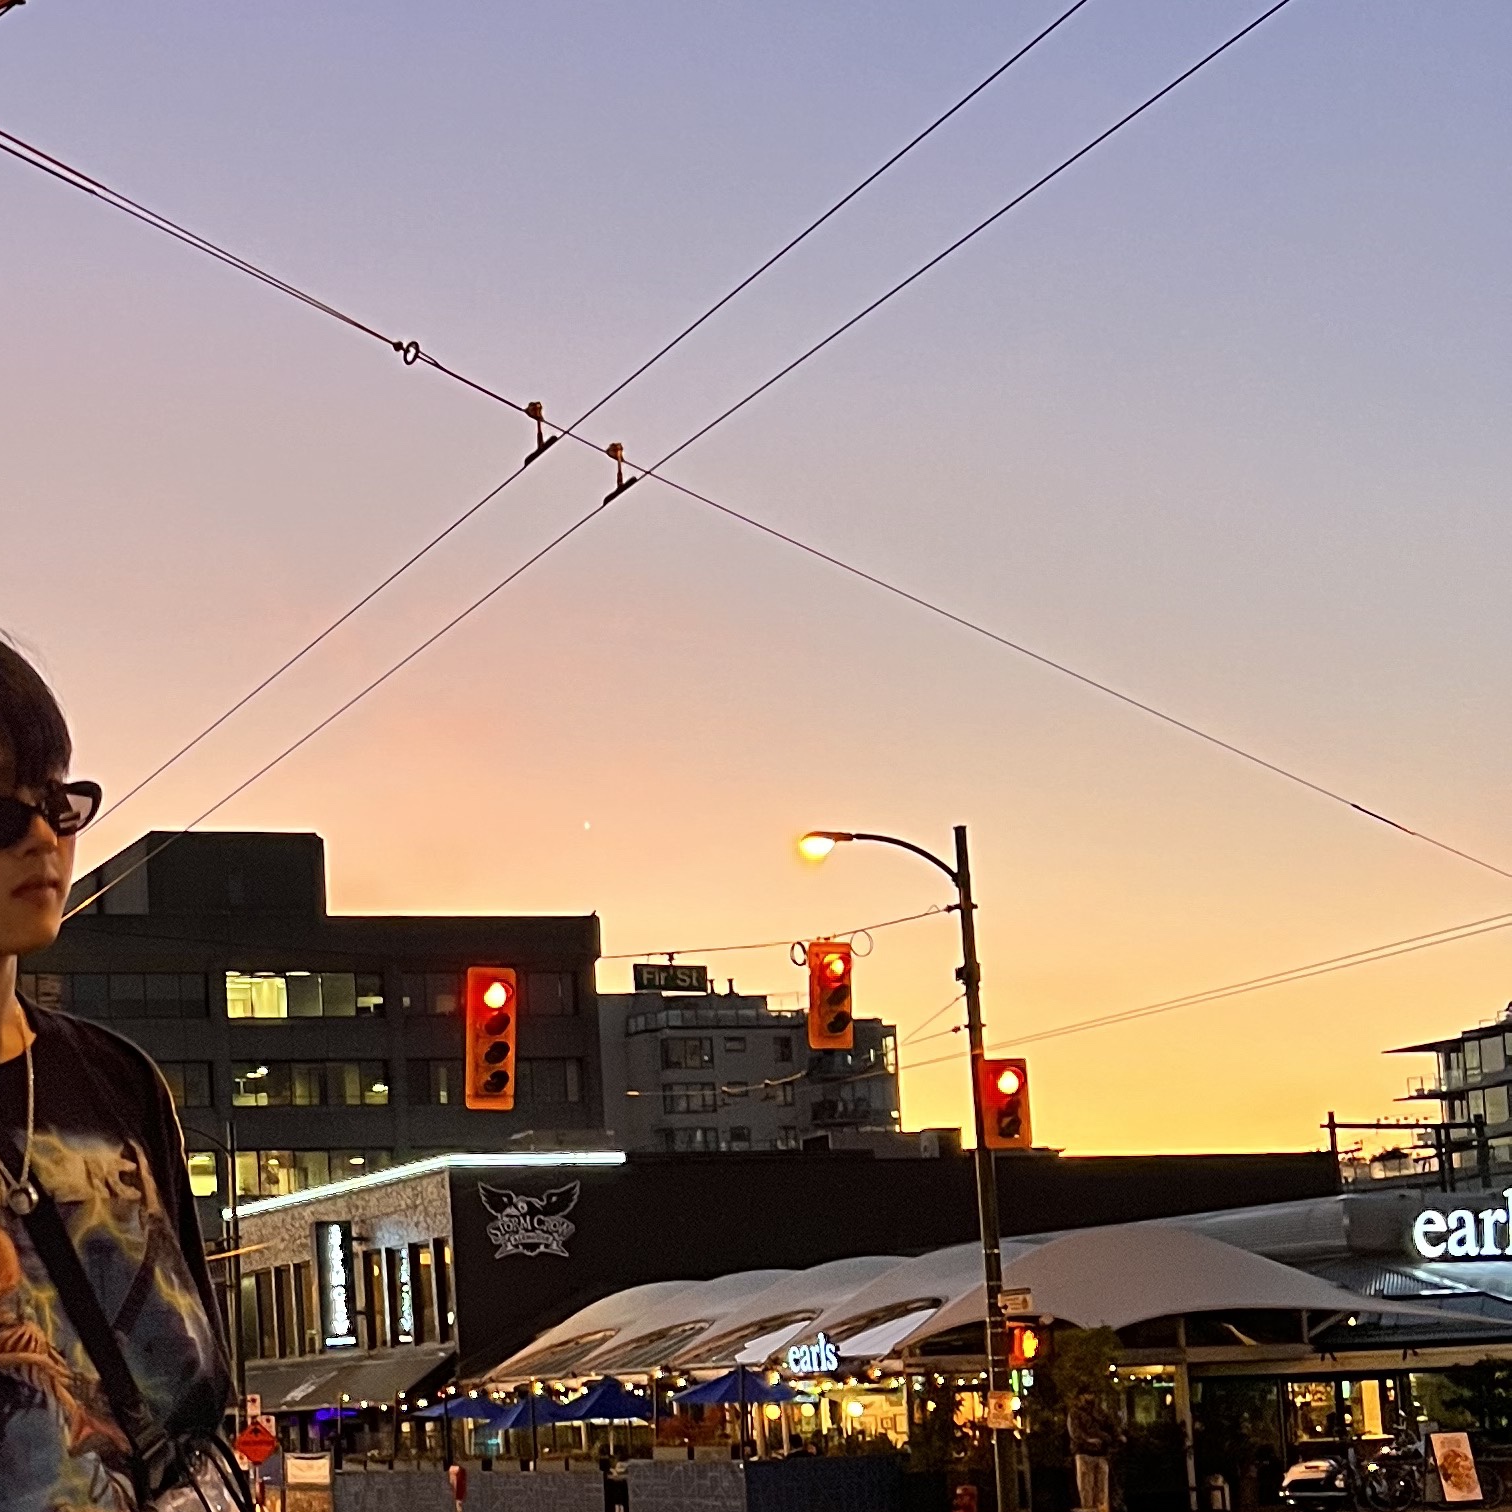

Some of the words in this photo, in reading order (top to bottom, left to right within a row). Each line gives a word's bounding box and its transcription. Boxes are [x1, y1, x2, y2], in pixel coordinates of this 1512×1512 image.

[642, 966, 667, 986] Fir
[676, 967, 699, 987] St
[788, 1331, 839, 1373] earls
